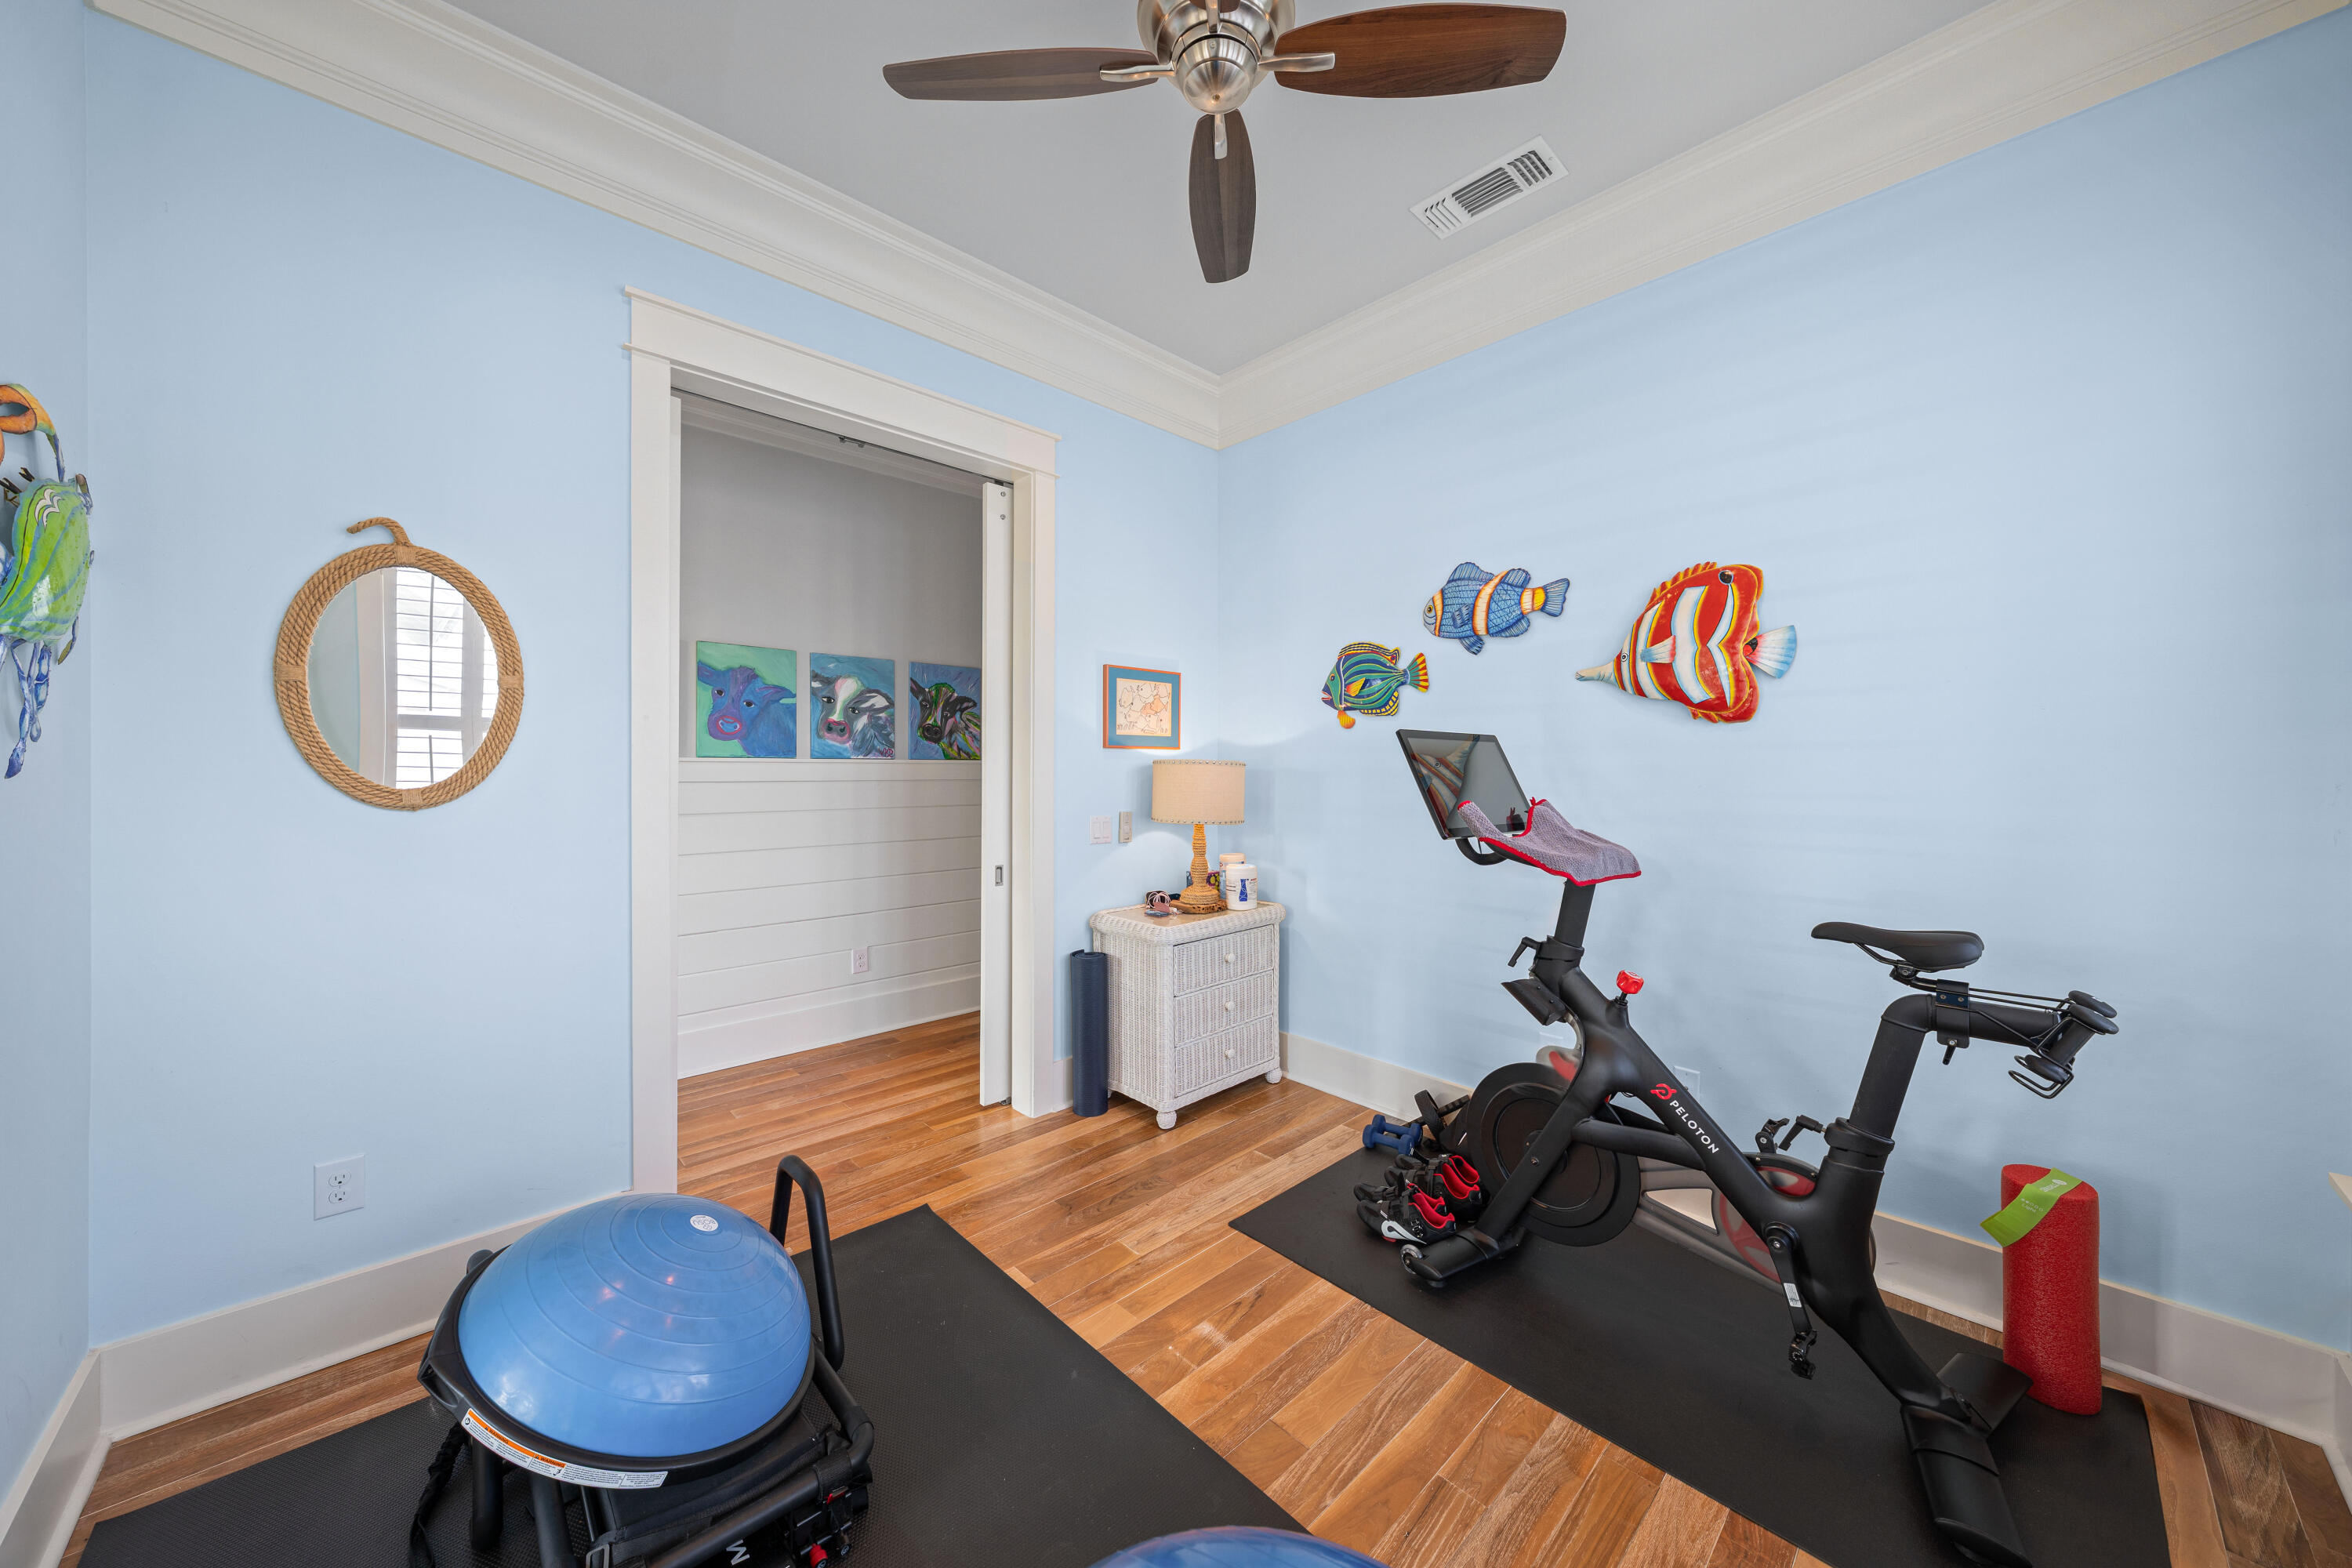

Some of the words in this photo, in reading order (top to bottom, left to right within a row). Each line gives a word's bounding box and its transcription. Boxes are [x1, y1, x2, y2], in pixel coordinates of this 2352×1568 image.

[1669, 1099, 1719, 1154] PELOTON
[488, 1428, 509, 1445] WARNING
[540, 1456, 566, 1468] WARNING
